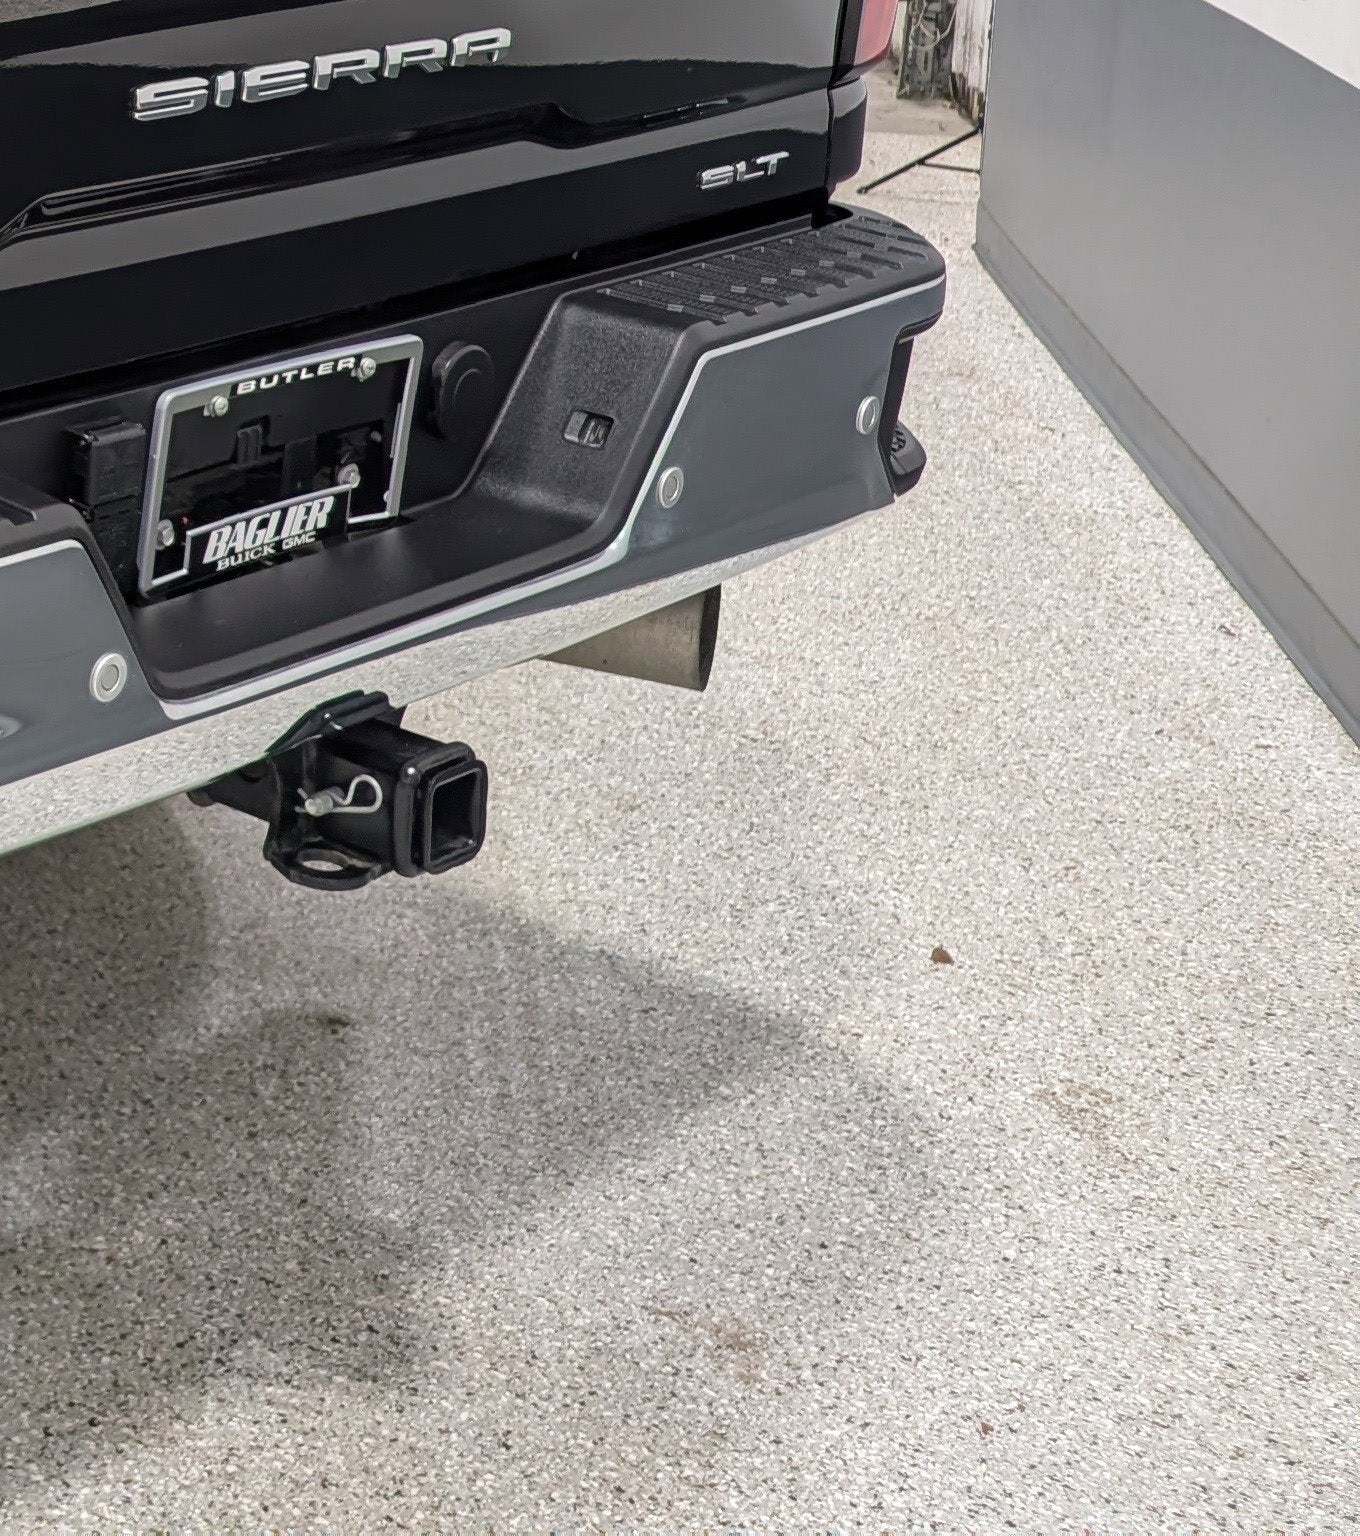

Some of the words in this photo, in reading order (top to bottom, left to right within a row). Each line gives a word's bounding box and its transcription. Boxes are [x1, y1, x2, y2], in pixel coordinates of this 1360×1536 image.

[132, 27, 511, 121] SIERRA
[698, 151, 789, 190] SLT
[236, 357, 356, 395] BUTLER
[203, 496, 335, 564] BAGLIER
[216, 543, 278, 572] BUICK
[281, 530, 317, 551] GMC
